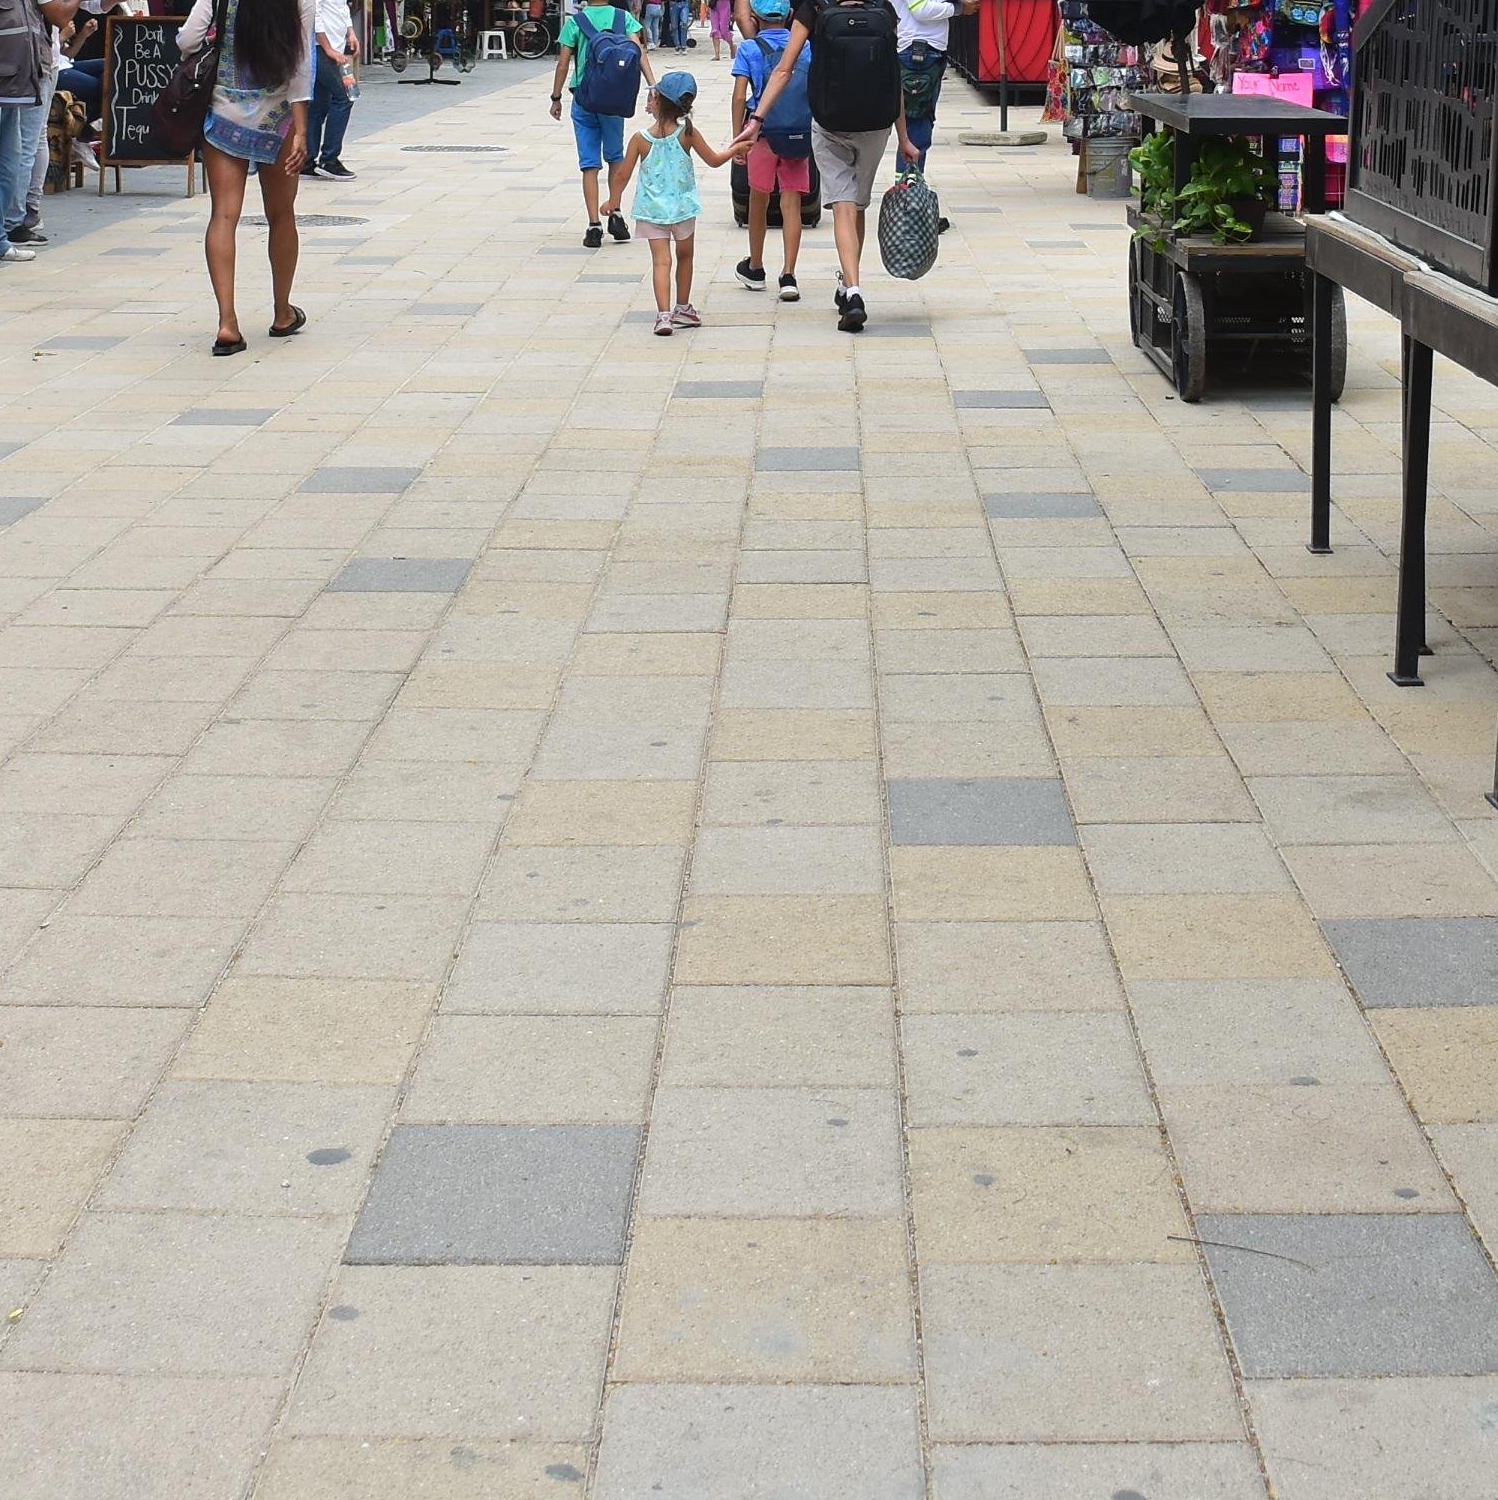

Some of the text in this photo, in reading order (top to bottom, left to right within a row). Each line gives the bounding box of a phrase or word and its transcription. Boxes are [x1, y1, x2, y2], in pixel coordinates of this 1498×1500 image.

[134, 43, 161, 59] Be A
[125, 59, 179, 88] PUSSY
[115, 106, 150, 144] Tequ
